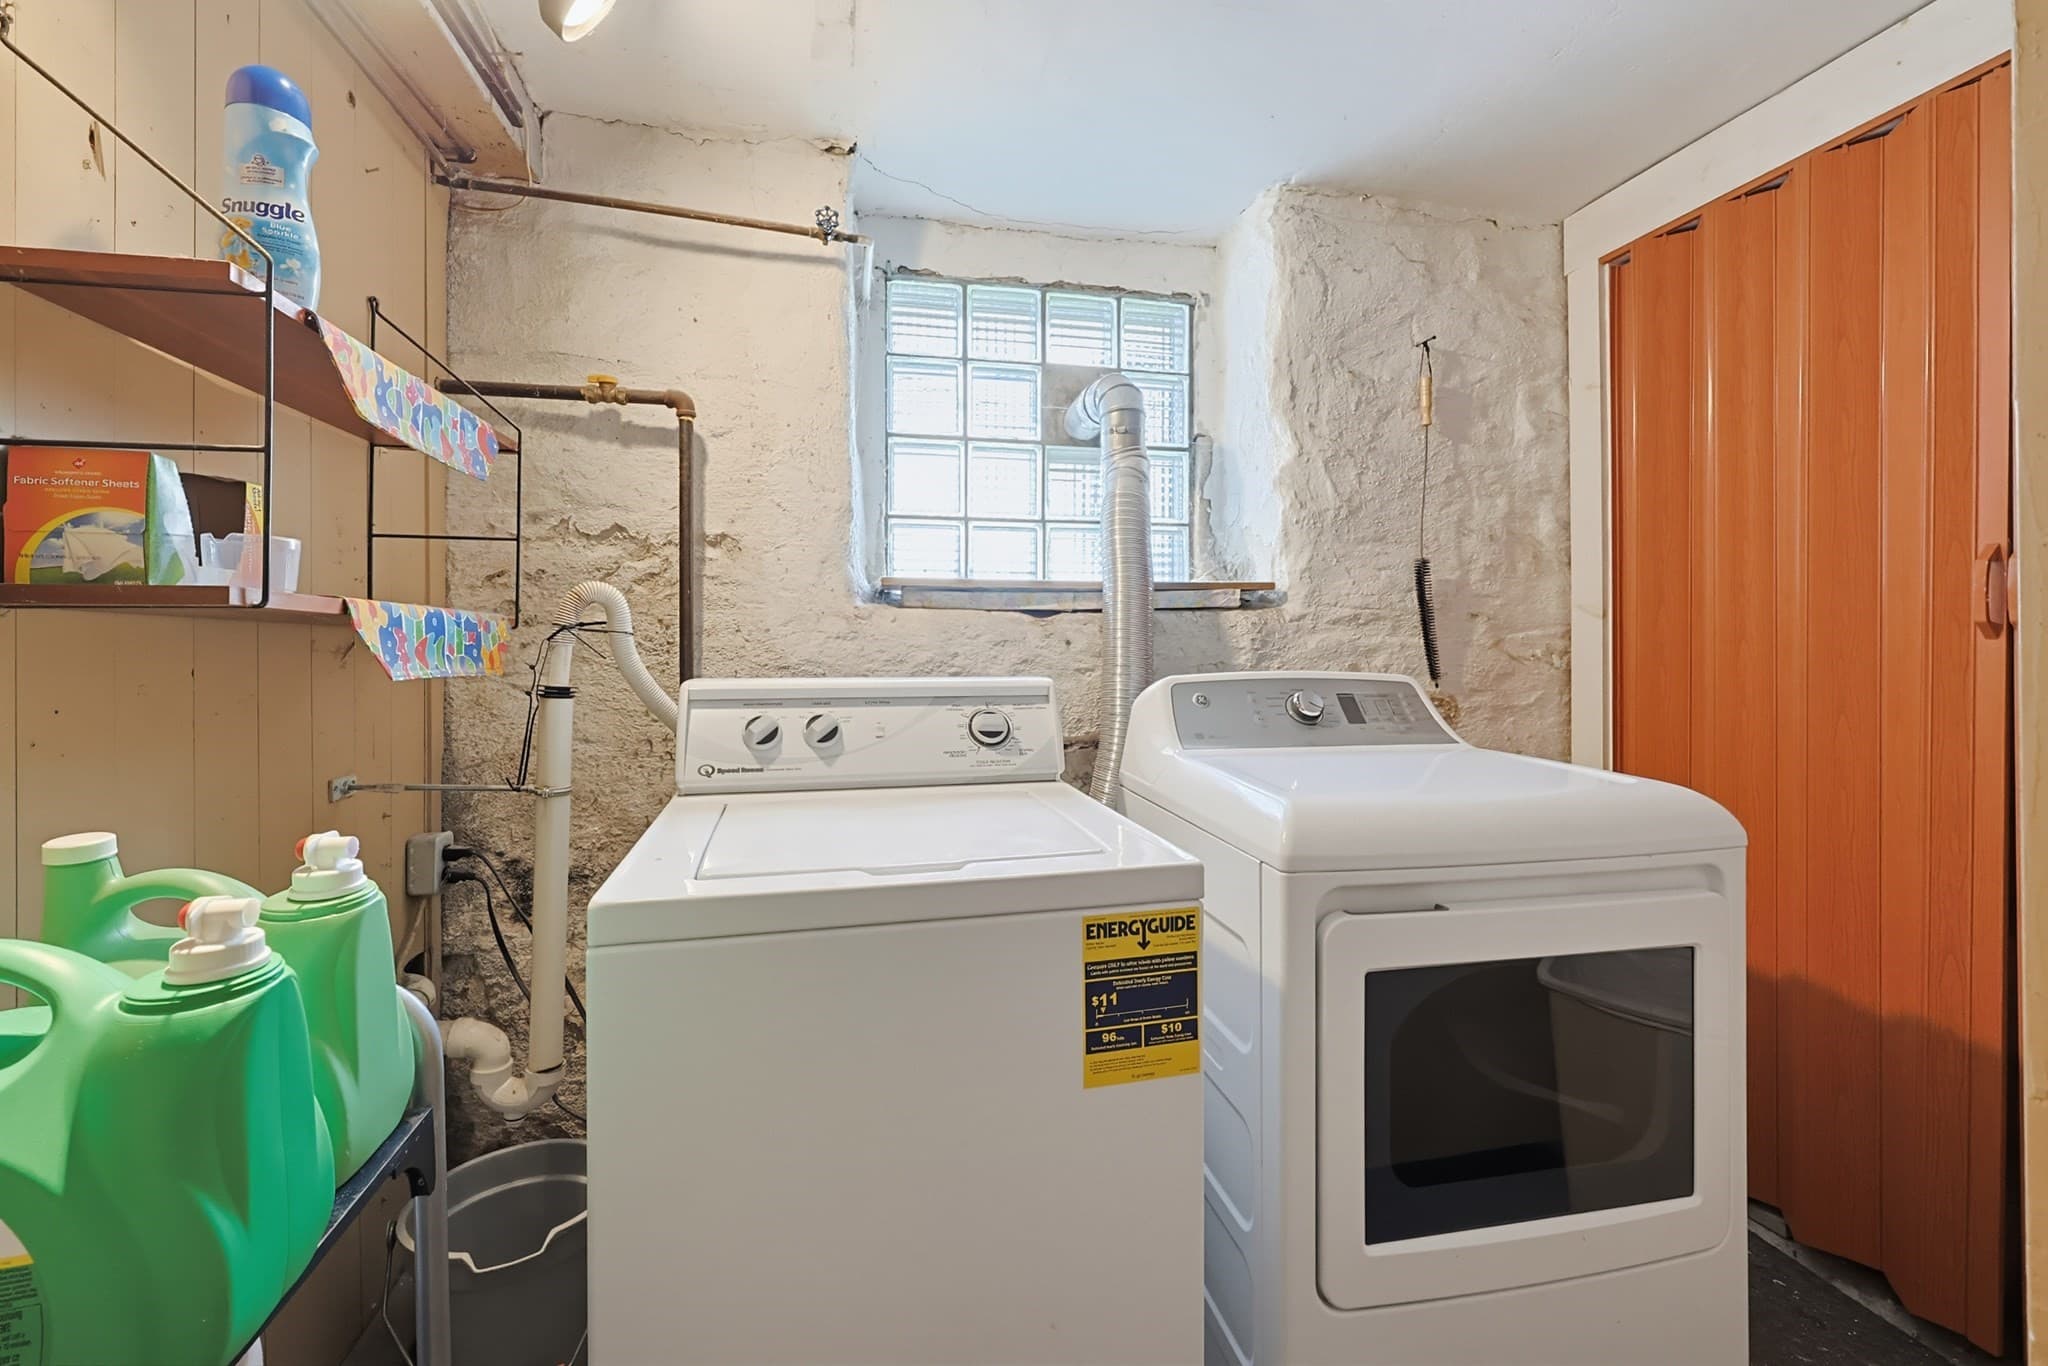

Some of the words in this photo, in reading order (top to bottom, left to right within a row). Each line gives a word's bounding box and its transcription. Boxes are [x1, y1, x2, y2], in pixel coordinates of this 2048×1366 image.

[221, 197, 305, 223] Snuggle
[13, 475, 49, 486] Fabric
[50, 477, 99, 487] Softener
[101, 479, 140, 489] Sheets
[1086, 914, 1196, 941] ENERGYGUIDE
[1091, 992, 1118, 1007] $11
[1161, 1022, 1182, 1034] $10
[1102, 1032, 1117, 1043] 96
